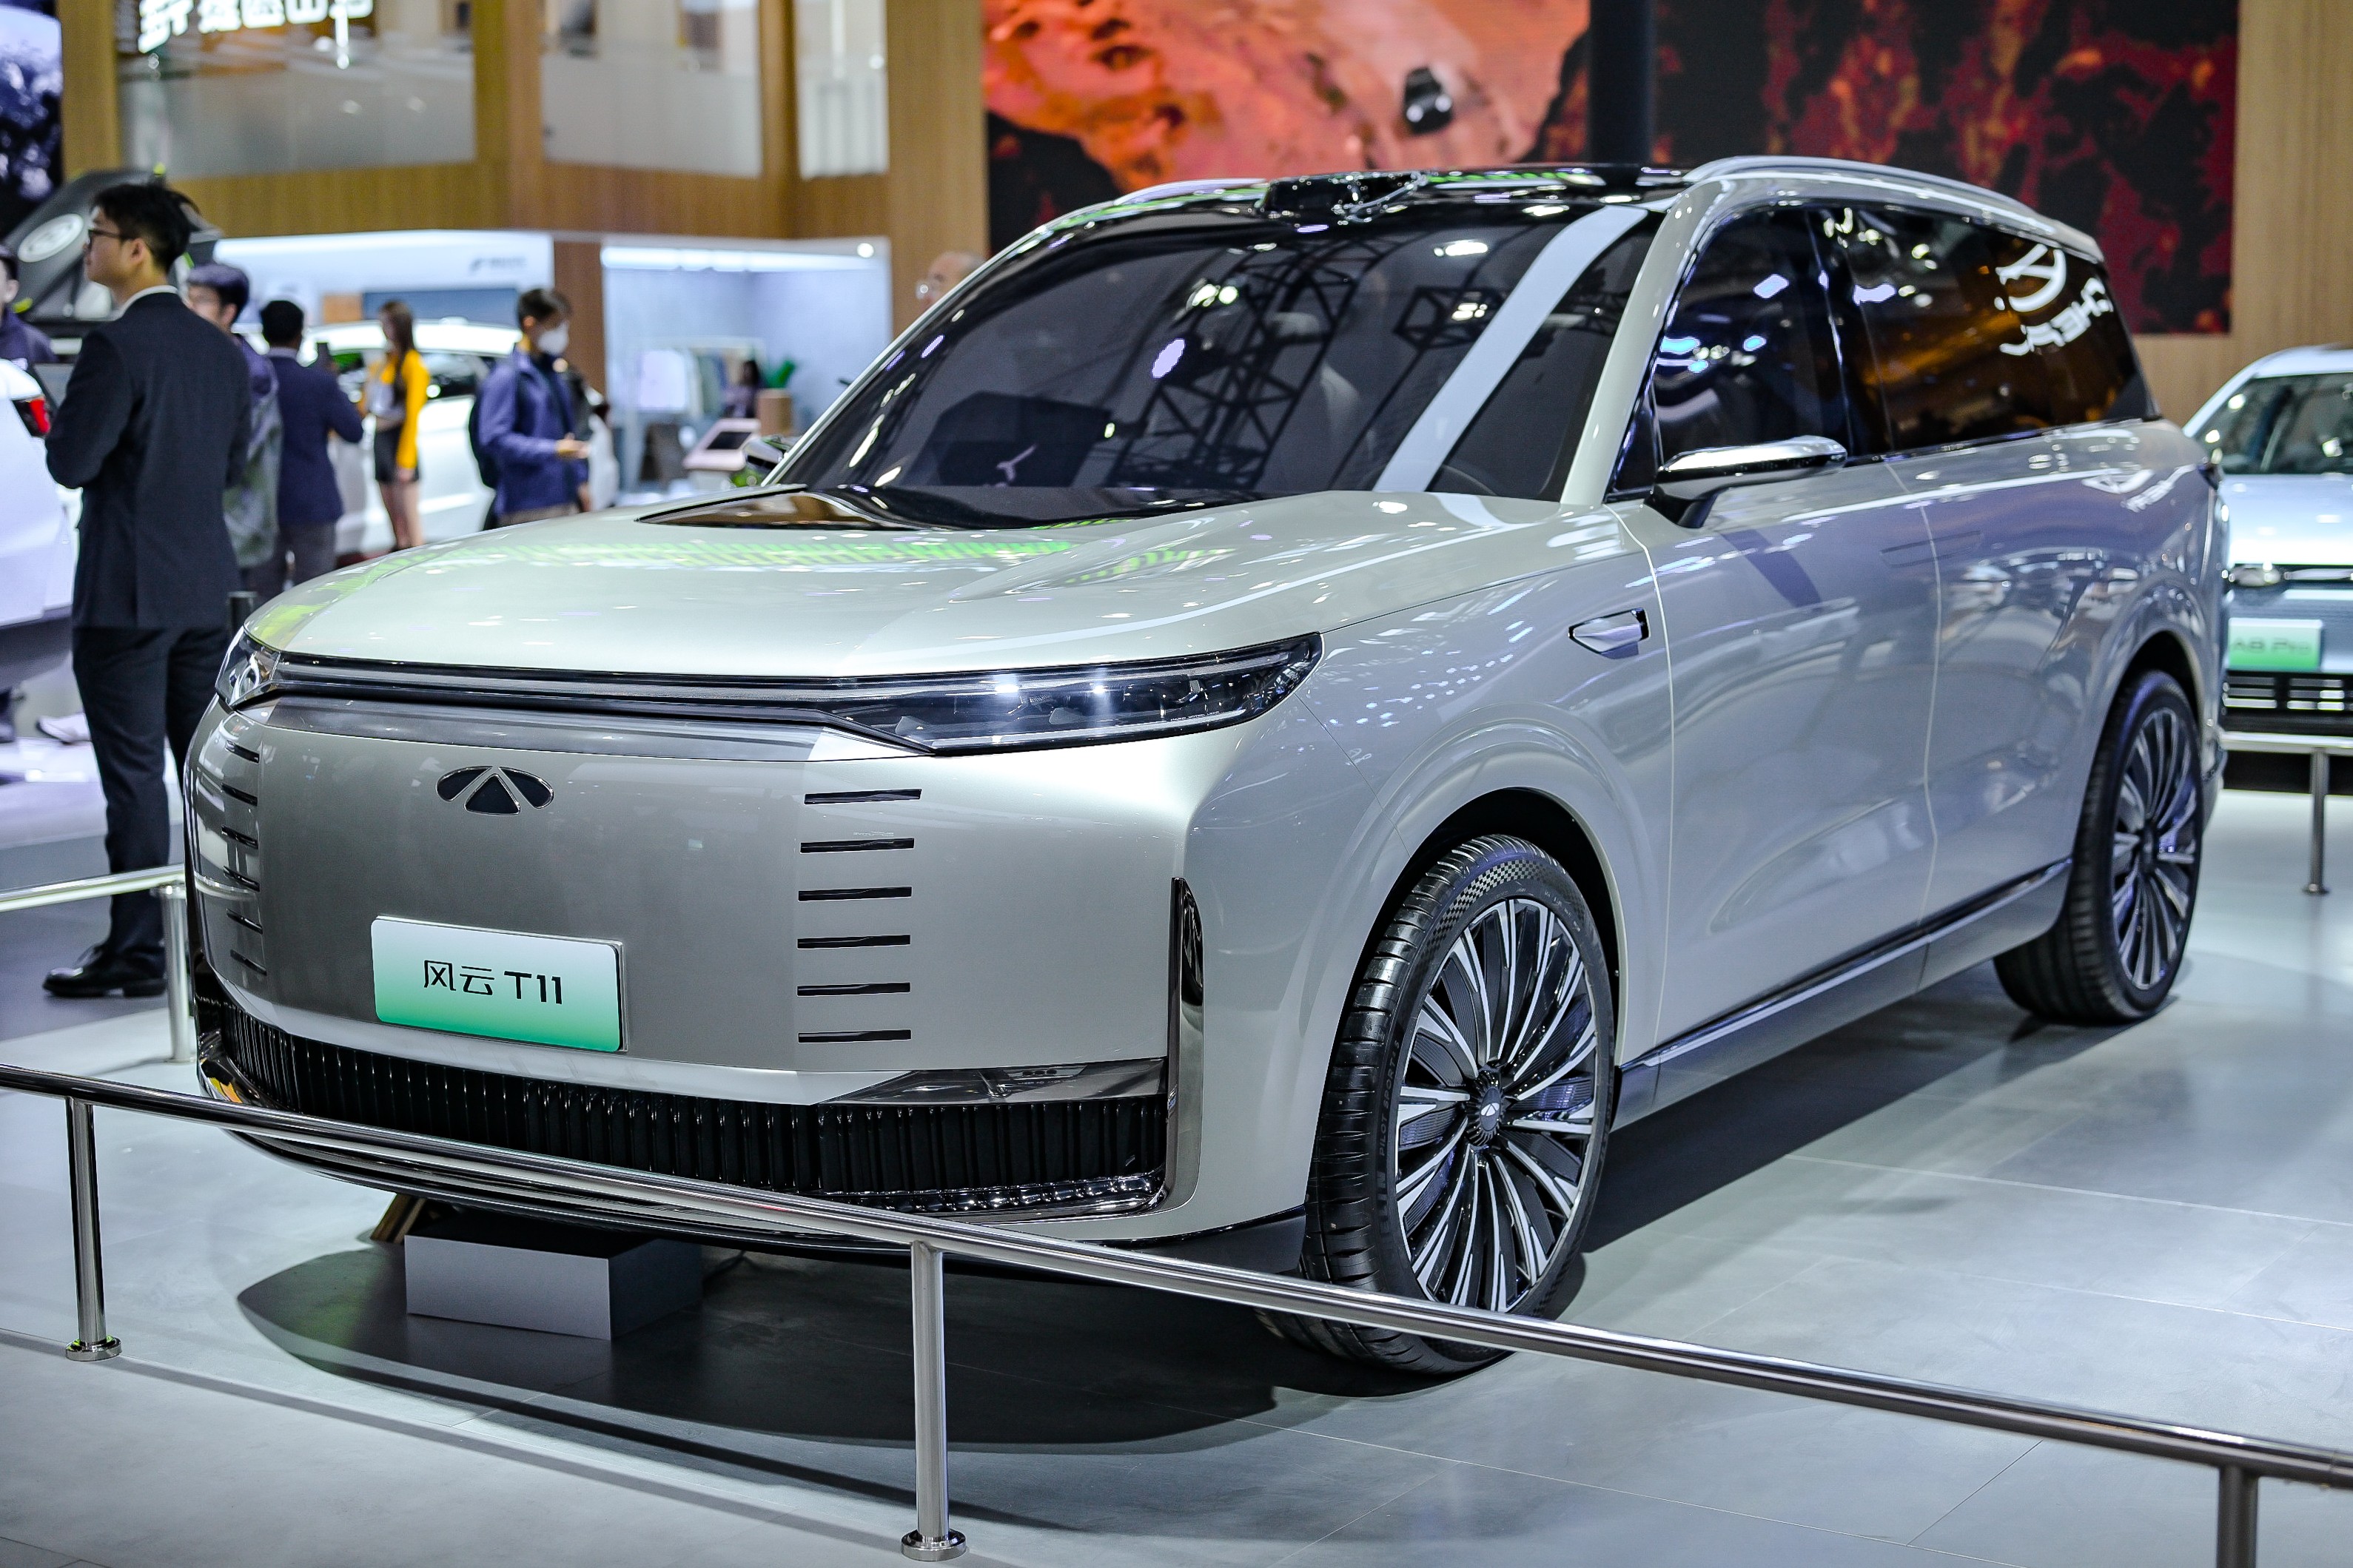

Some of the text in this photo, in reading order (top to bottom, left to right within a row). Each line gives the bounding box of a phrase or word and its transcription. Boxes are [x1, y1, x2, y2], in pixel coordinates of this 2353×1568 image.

[423, 960, 563, 1005] 风云 T11
[1380, 1114, 1388, 1156] PILOT
